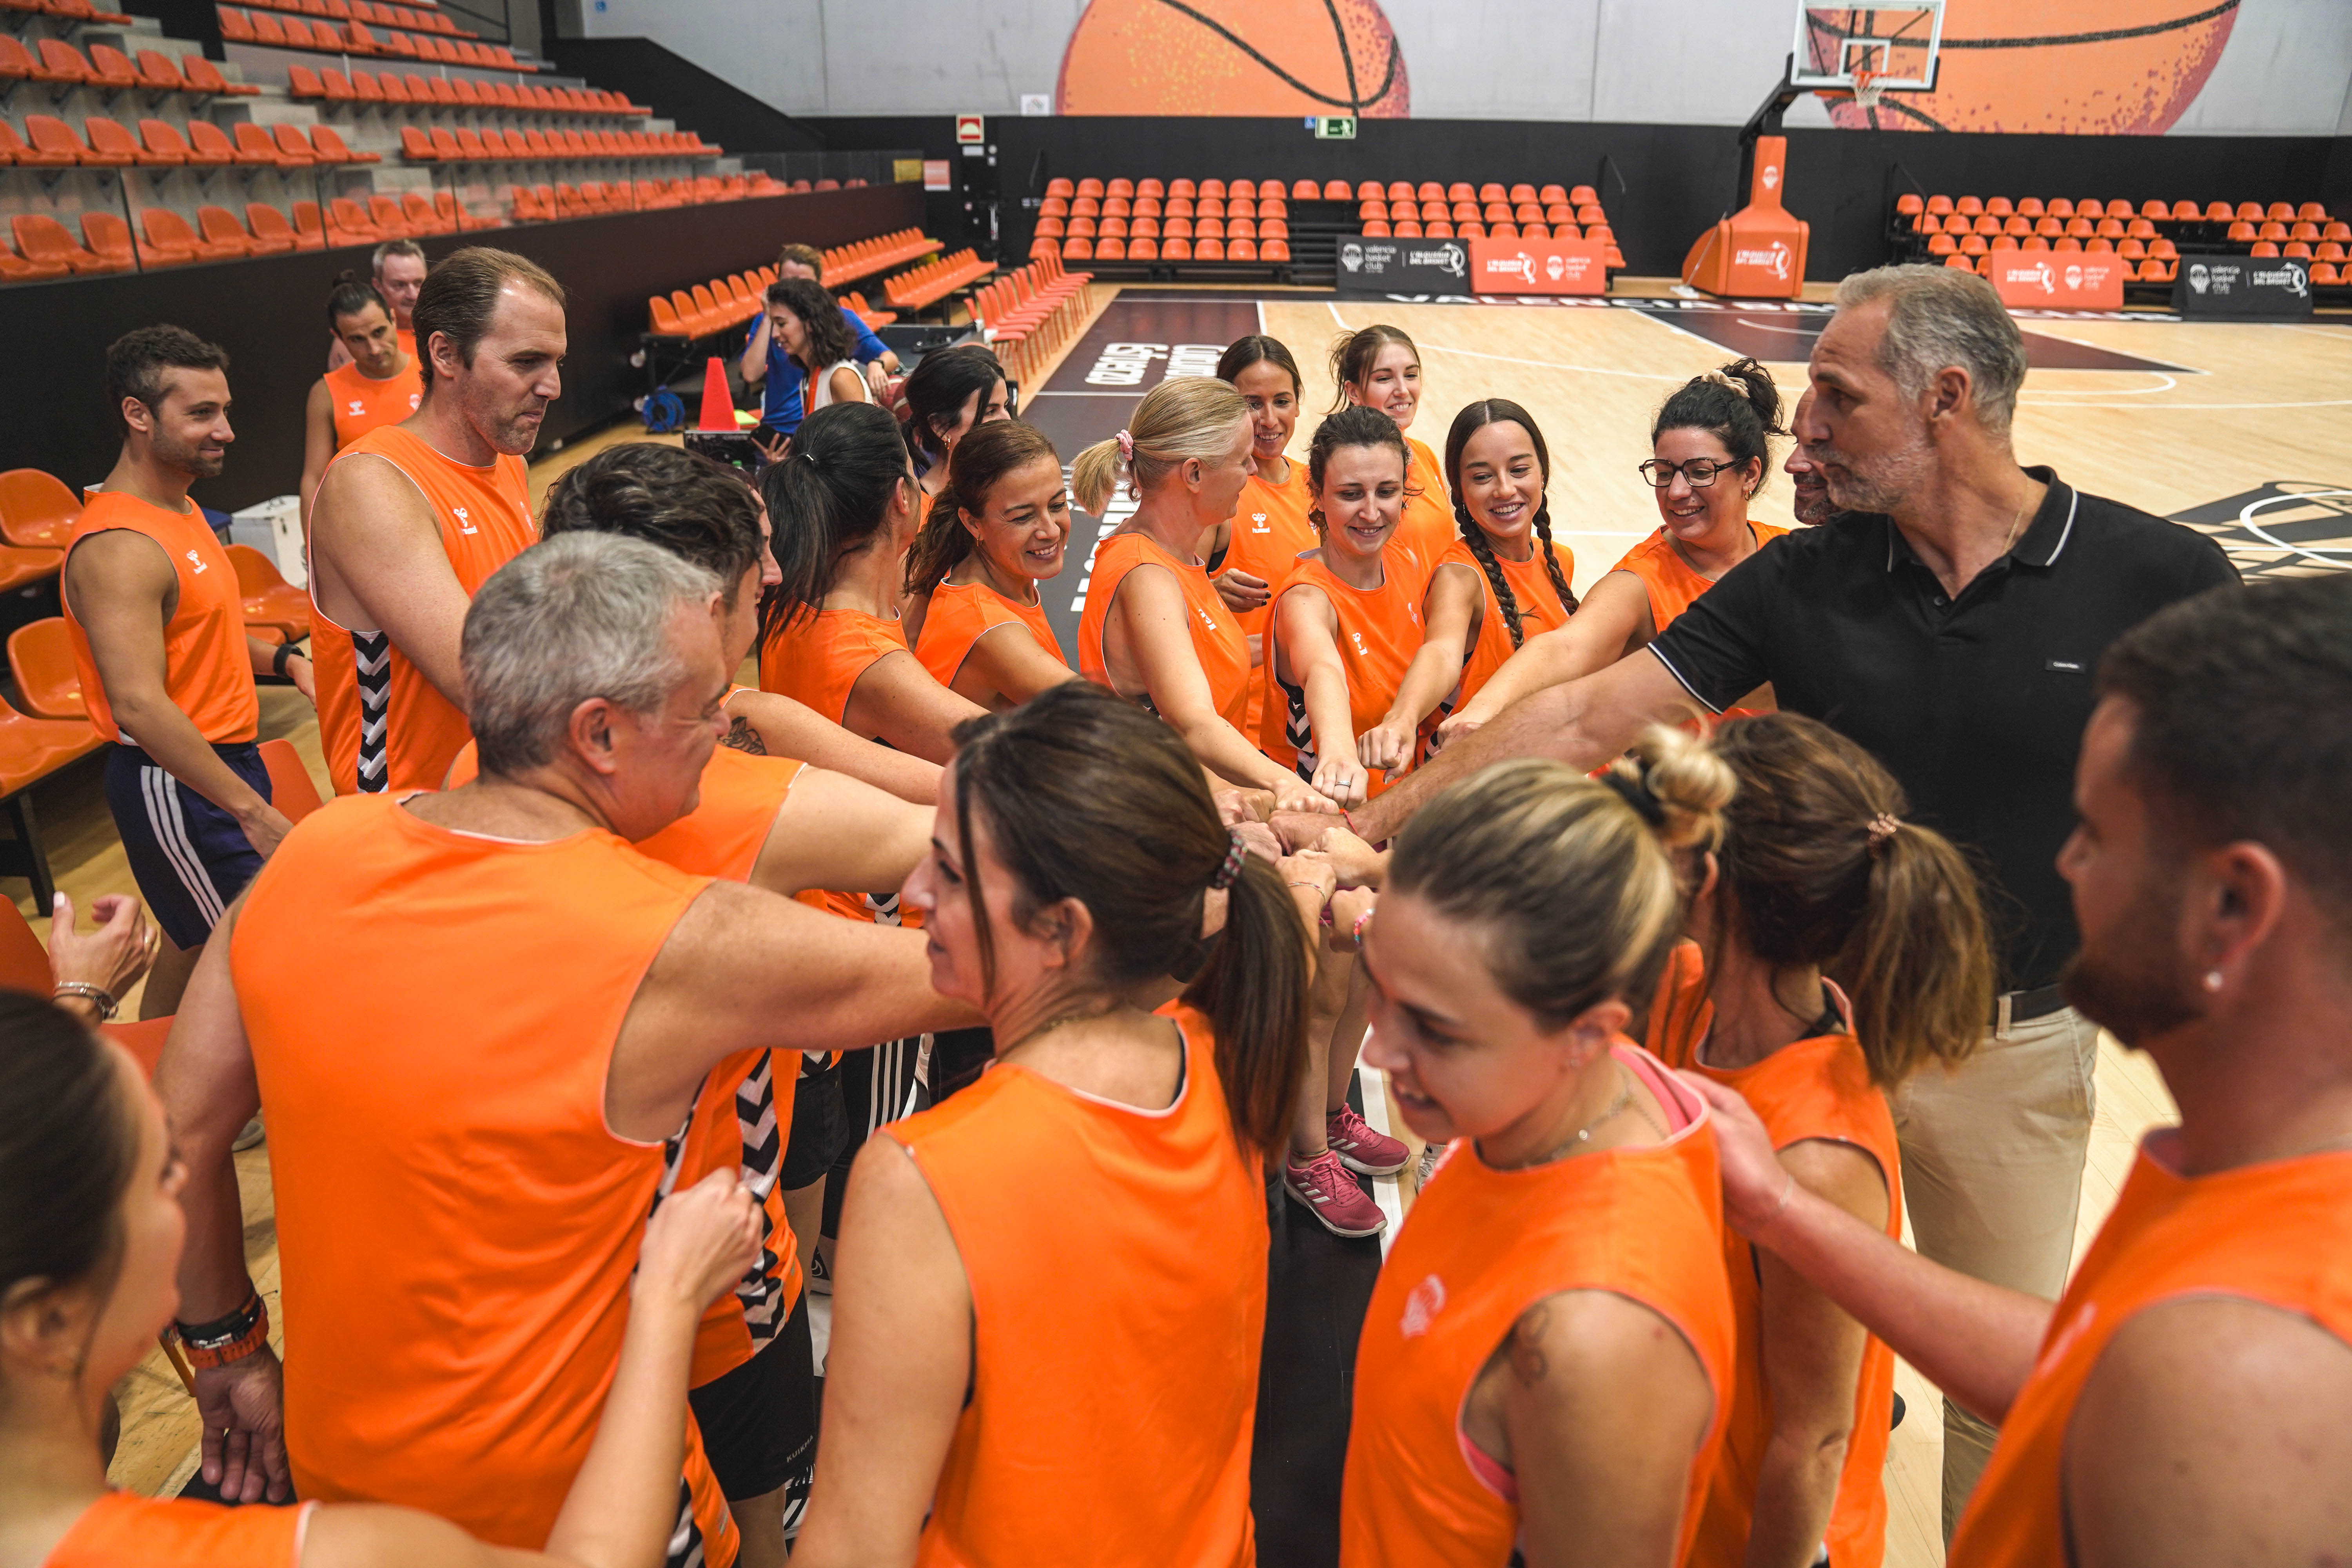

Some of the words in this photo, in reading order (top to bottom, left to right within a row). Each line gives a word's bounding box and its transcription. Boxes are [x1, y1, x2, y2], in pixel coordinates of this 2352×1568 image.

[1365, 244, 1397, 254] valencia
[1365, 253, 1392, 263] basket
[1365, 261, 1385, 270] club
[1386, 294, 1725, 310] VALENCIA
